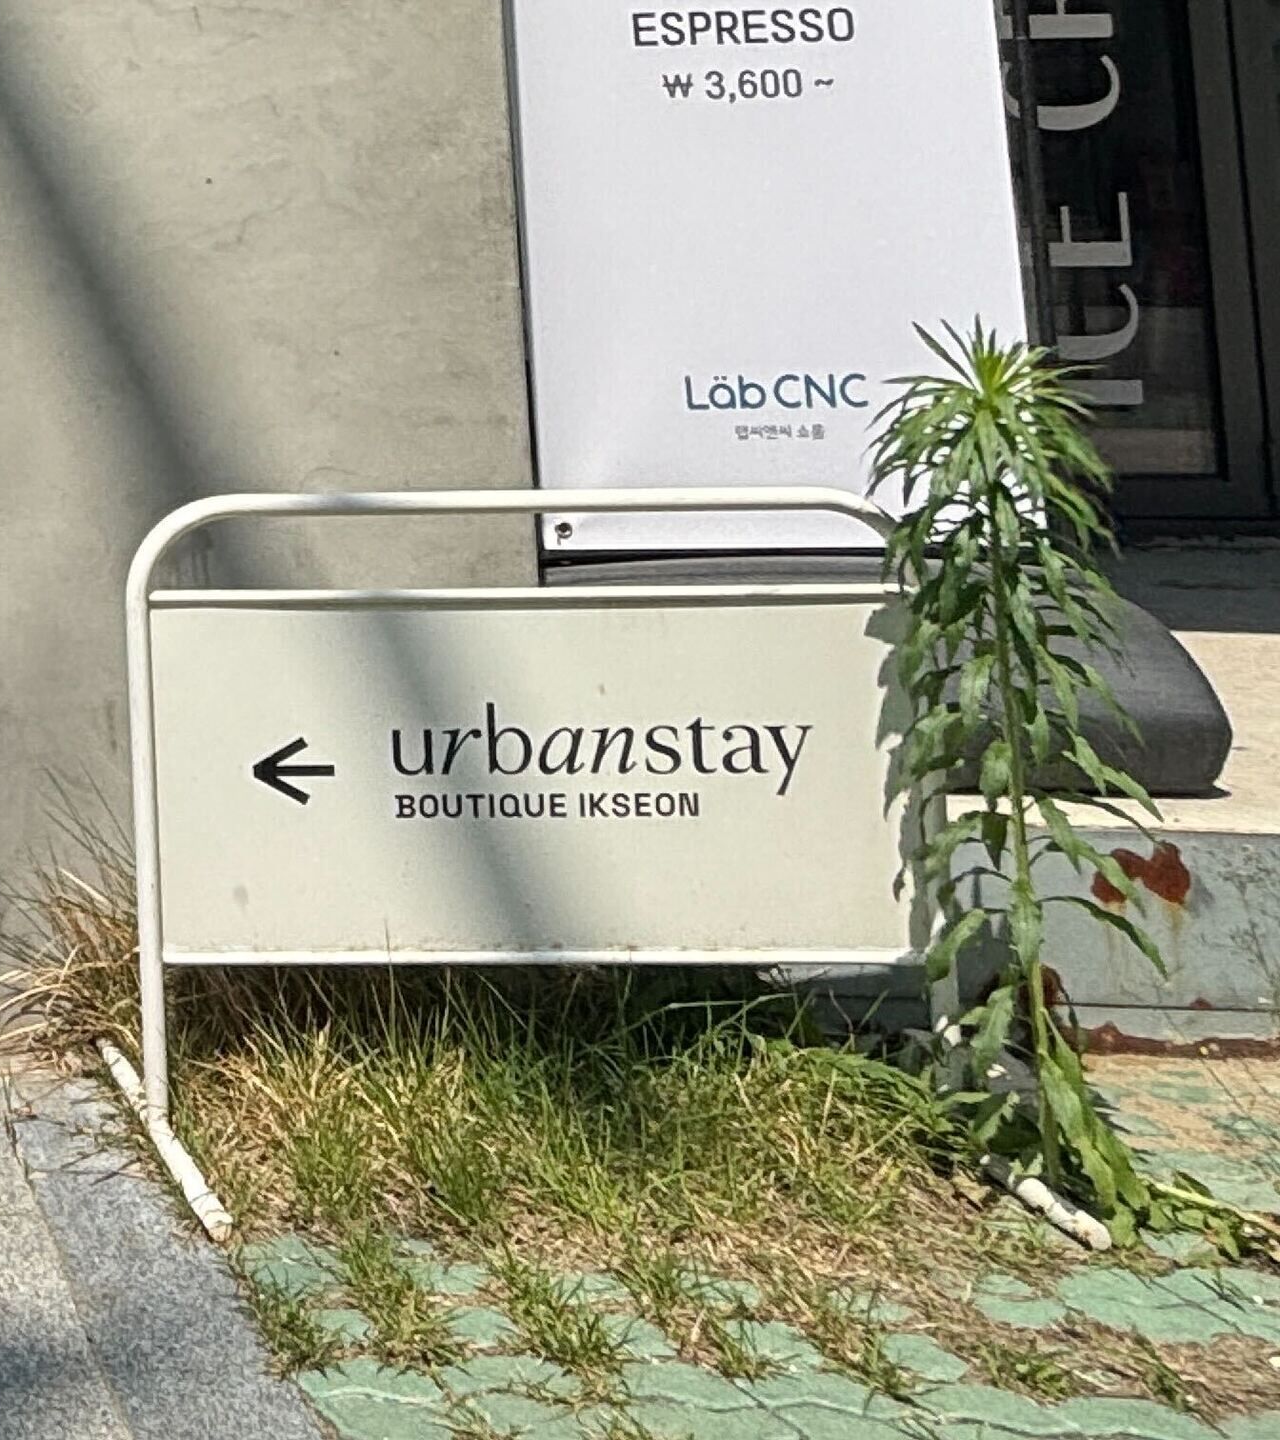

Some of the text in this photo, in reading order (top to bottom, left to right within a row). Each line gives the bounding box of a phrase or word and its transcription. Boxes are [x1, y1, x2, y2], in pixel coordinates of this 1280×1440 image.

[632, 7, 855, 47] ESPRESSO
[704, 68, 803, 104] 3,600
[1048, 191, 1144, 406] ICE
[773, 373, 869, 409] CNC
[391, 701, 814, 796] urbanstay
[394, 791, 700, 819] BOUTIQUE IKSEON
